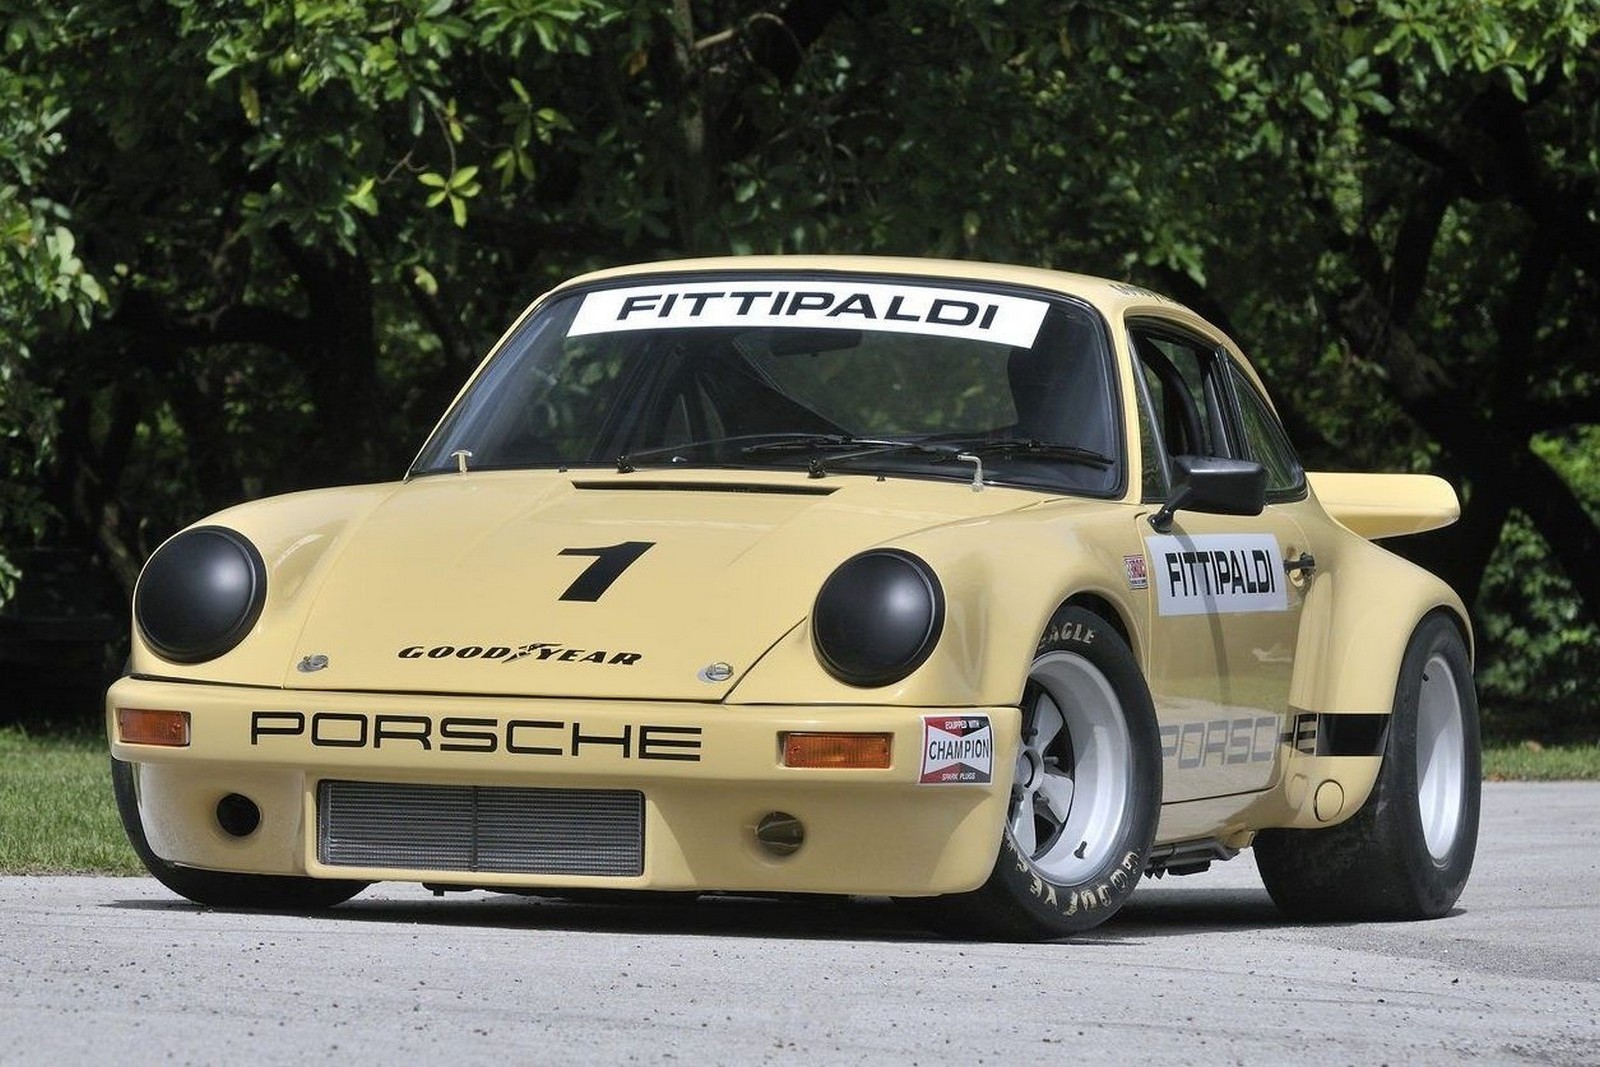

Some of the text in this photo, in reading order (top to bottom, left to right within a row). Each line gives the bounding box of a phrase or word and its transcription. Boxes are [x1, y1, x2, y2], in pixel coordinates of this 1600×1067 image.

[617, 290, 1000, 330] FITTIPALDI
[558, 541, 655, 603] 1
[1165, 549, 1276, 598] FITTIPALDI
[251, 711, 702, 762] PORSCHE
[945, 720, 967, 730] EQUIPPED
[929, 739, 989, 760] CHAMPION
[959, 772, 976, 780] PLUGS
